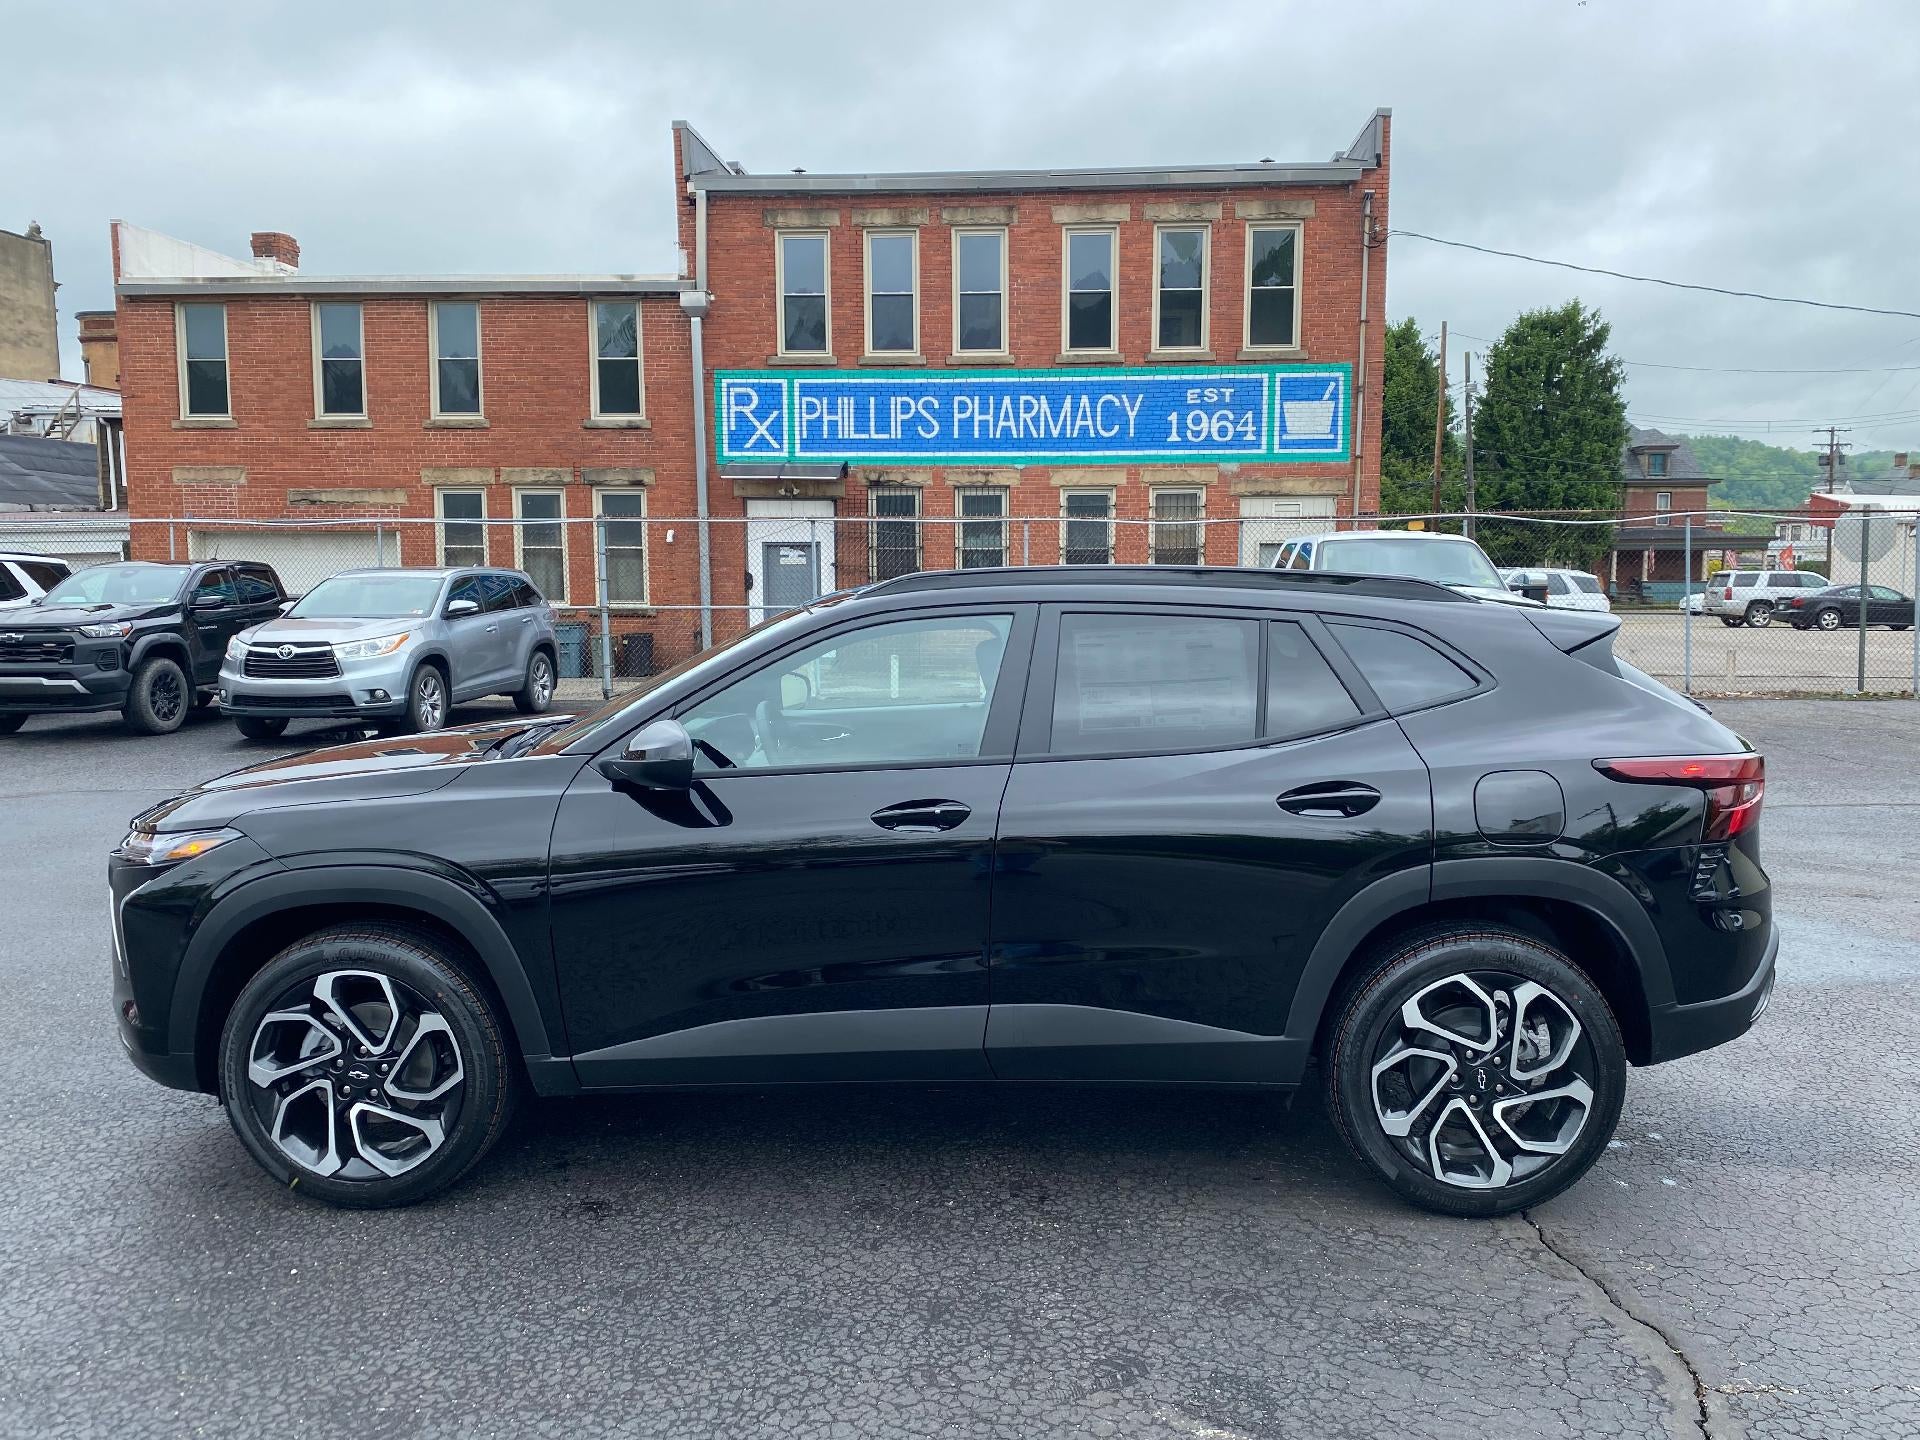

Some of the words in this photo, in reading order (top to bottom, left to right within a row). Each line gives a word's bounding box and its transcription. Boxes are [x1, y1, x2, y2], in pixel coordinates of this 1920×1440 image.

[1186, 388, 1235, 404] EST
[801, 396, 940, 439] PHILLIPS
[953, 394, 1144, 439] PHARMACY
[1166, 410, 1257, 442] 1964
